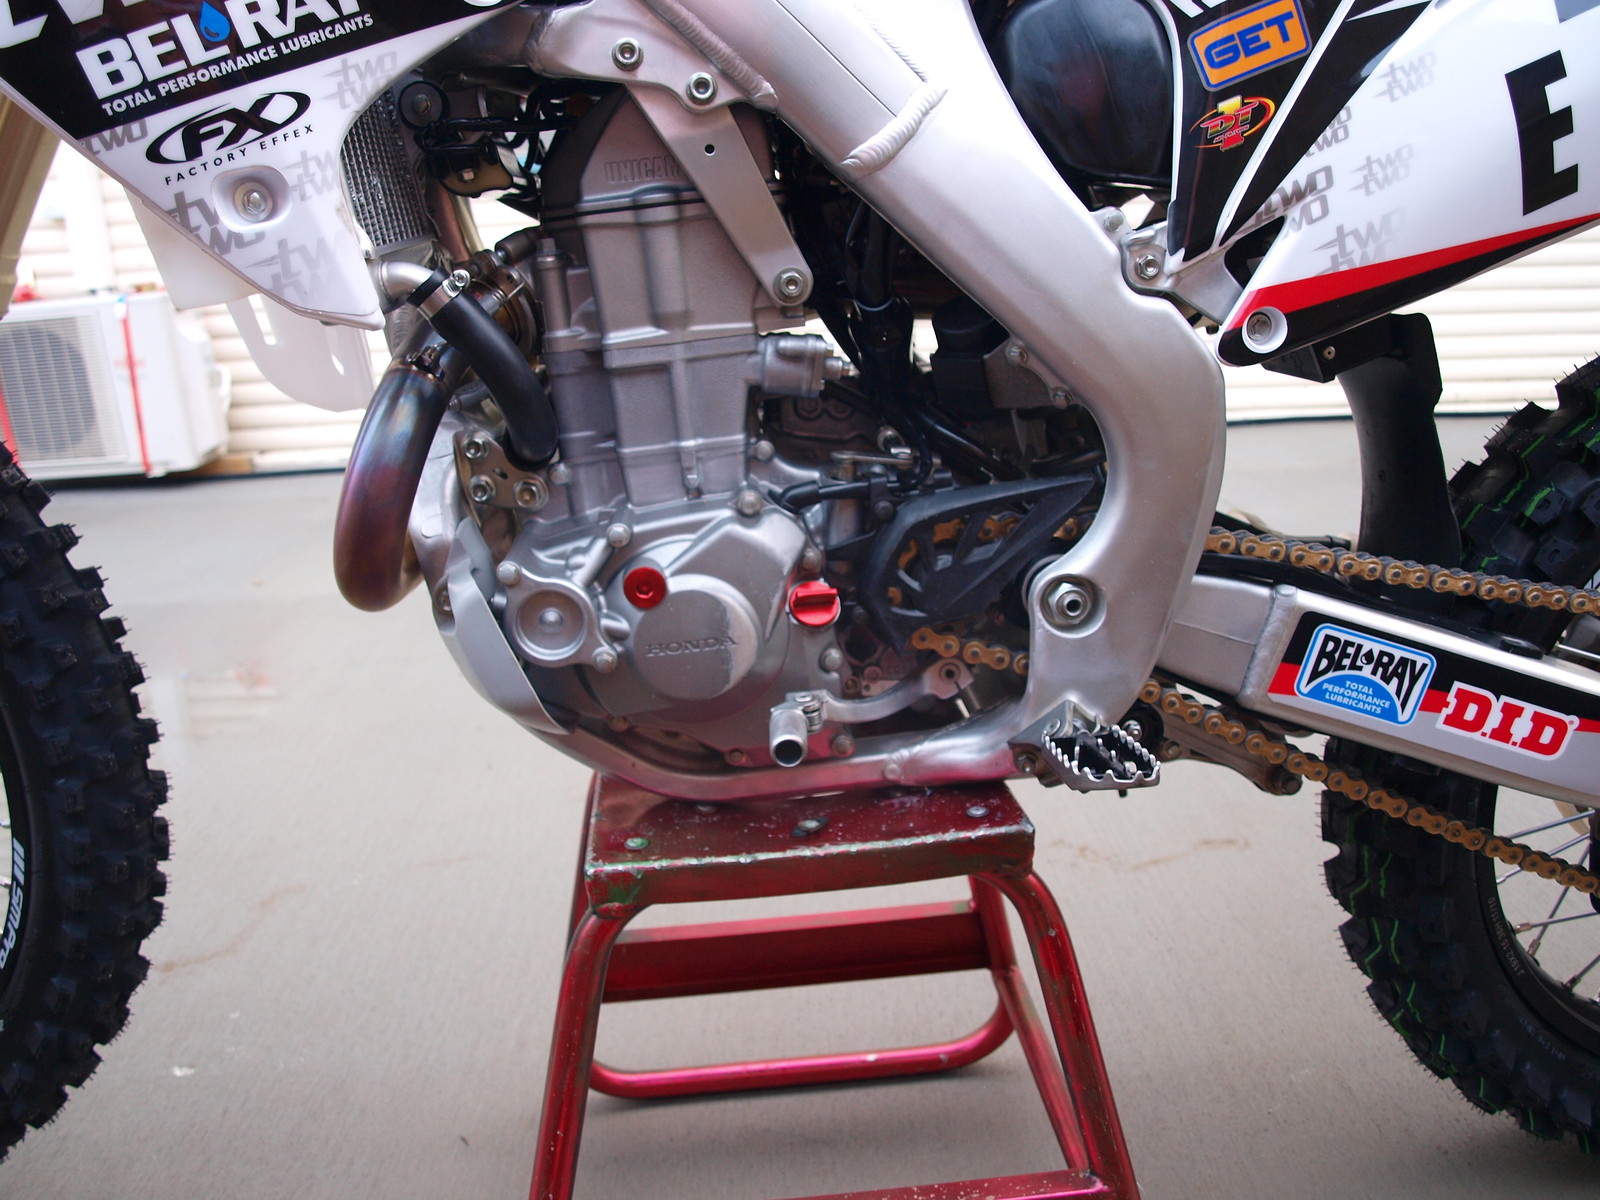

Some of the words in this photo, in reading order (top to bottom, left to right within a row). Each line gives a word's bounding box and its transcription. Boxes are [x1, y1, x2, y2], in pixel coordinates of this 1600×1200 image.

[101, 89, 156, 116] TOTAL
[158, 44, 278, 95] PERFORMANCE
[280, 13, 374, 55] LUBRICANTS
[1203, 10, 1295, 69] GET
[164, 148, 248, 186] FACTORY
[259, 124, 314, 151] EFFEX
[178, 92, 285, 163] FX
[1505, 50, 1579, 216] E
[645, 636, 739, 658] HONDA
[1322, 683, 1391, 708] PERFORMANCE
[1325, 692, 1382, 714] LUBRICANTS
[1345, 680, 1373, 695] TOTAL
